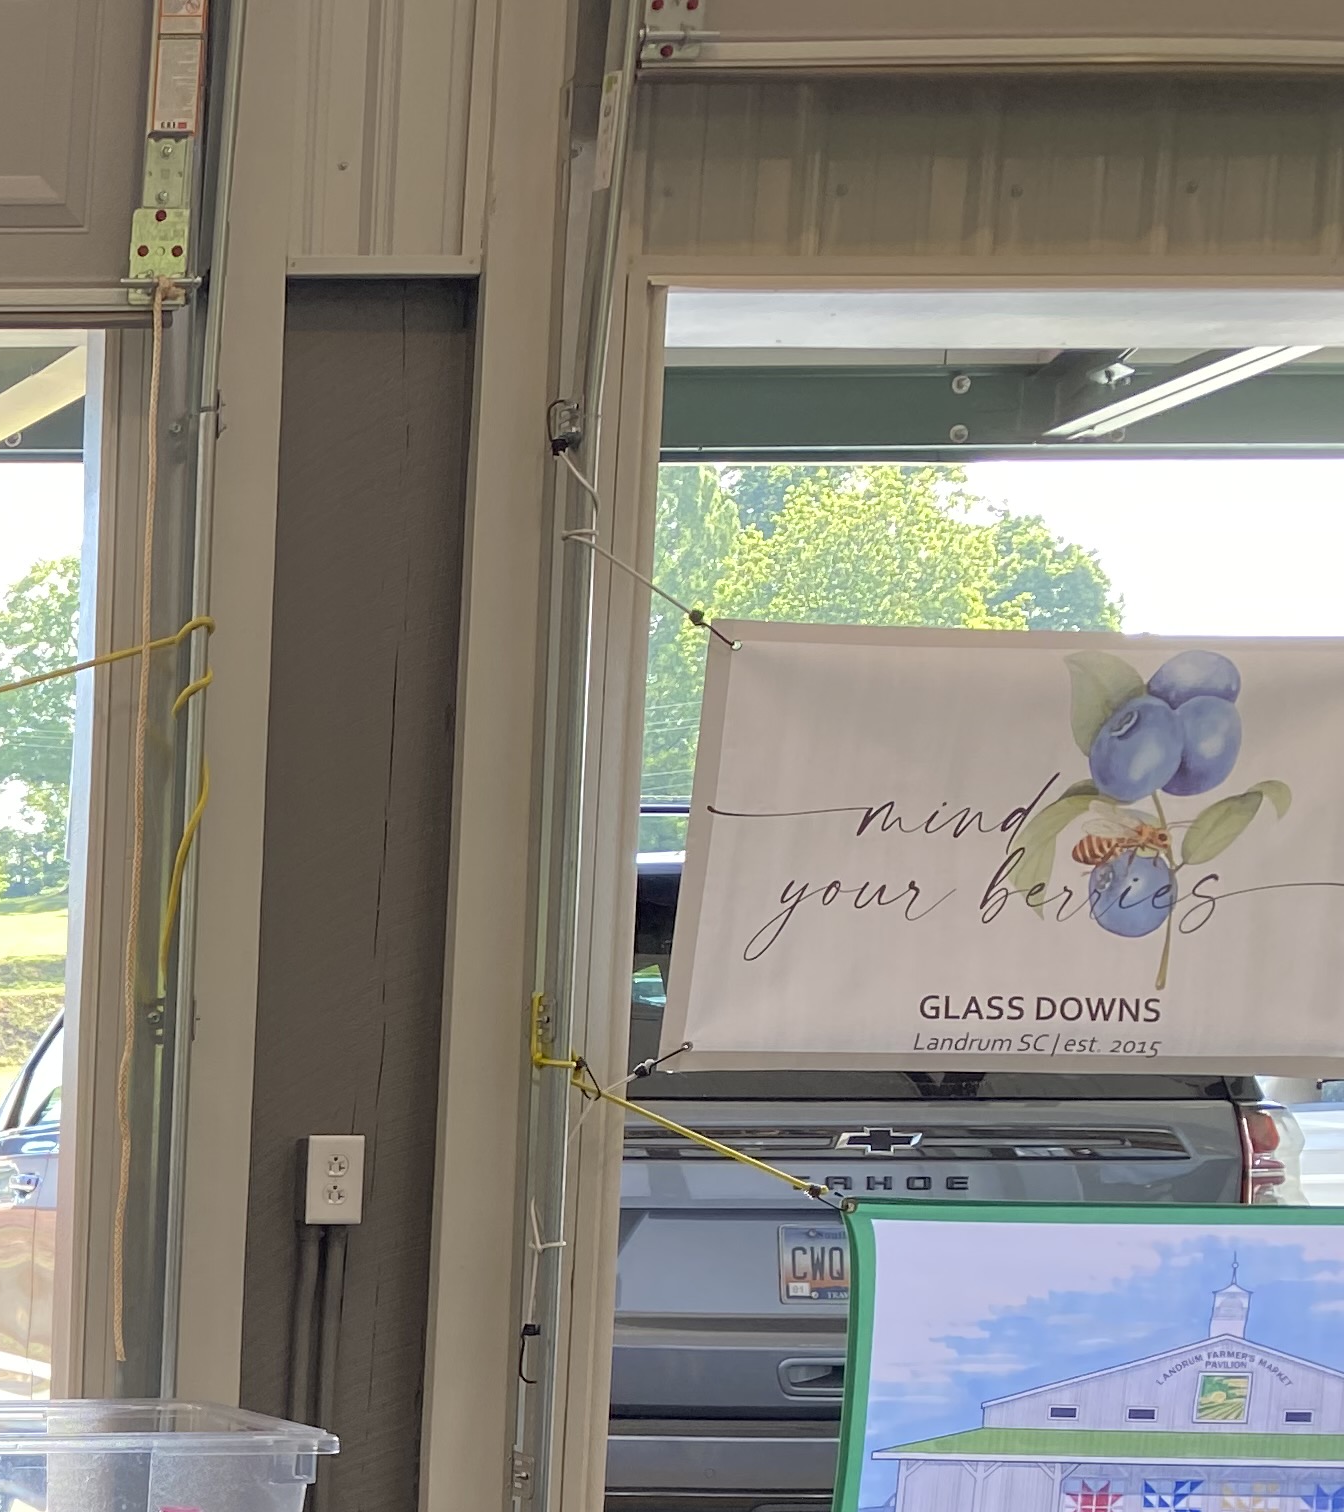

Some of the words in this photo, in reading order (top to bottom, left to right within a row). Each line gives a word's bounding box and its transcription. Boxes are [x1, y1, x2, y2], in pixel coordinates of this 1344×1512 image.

[707, 773, 1060, 850] mind
[743, 875, 957, 962] your
[980, 847, 1344, 936] berries
[919, 995, 1025, 1020] GLASS
[1035, 997, 1161, 1022] DOWNS
[914, 1032, 1012, 1051] Landrum
[1110, 1040, 1162, 1058] 2015
[792, 1246, 844, 1281] CWQ
[1156, 1354, 1204, 1386] LANDRUM
[1207, 1350, 1256, 1363] FARMER'S
[1258, 1358, 1294, 1387] MARKET
[1205, 1360, 1247, 1369] PAVILION
